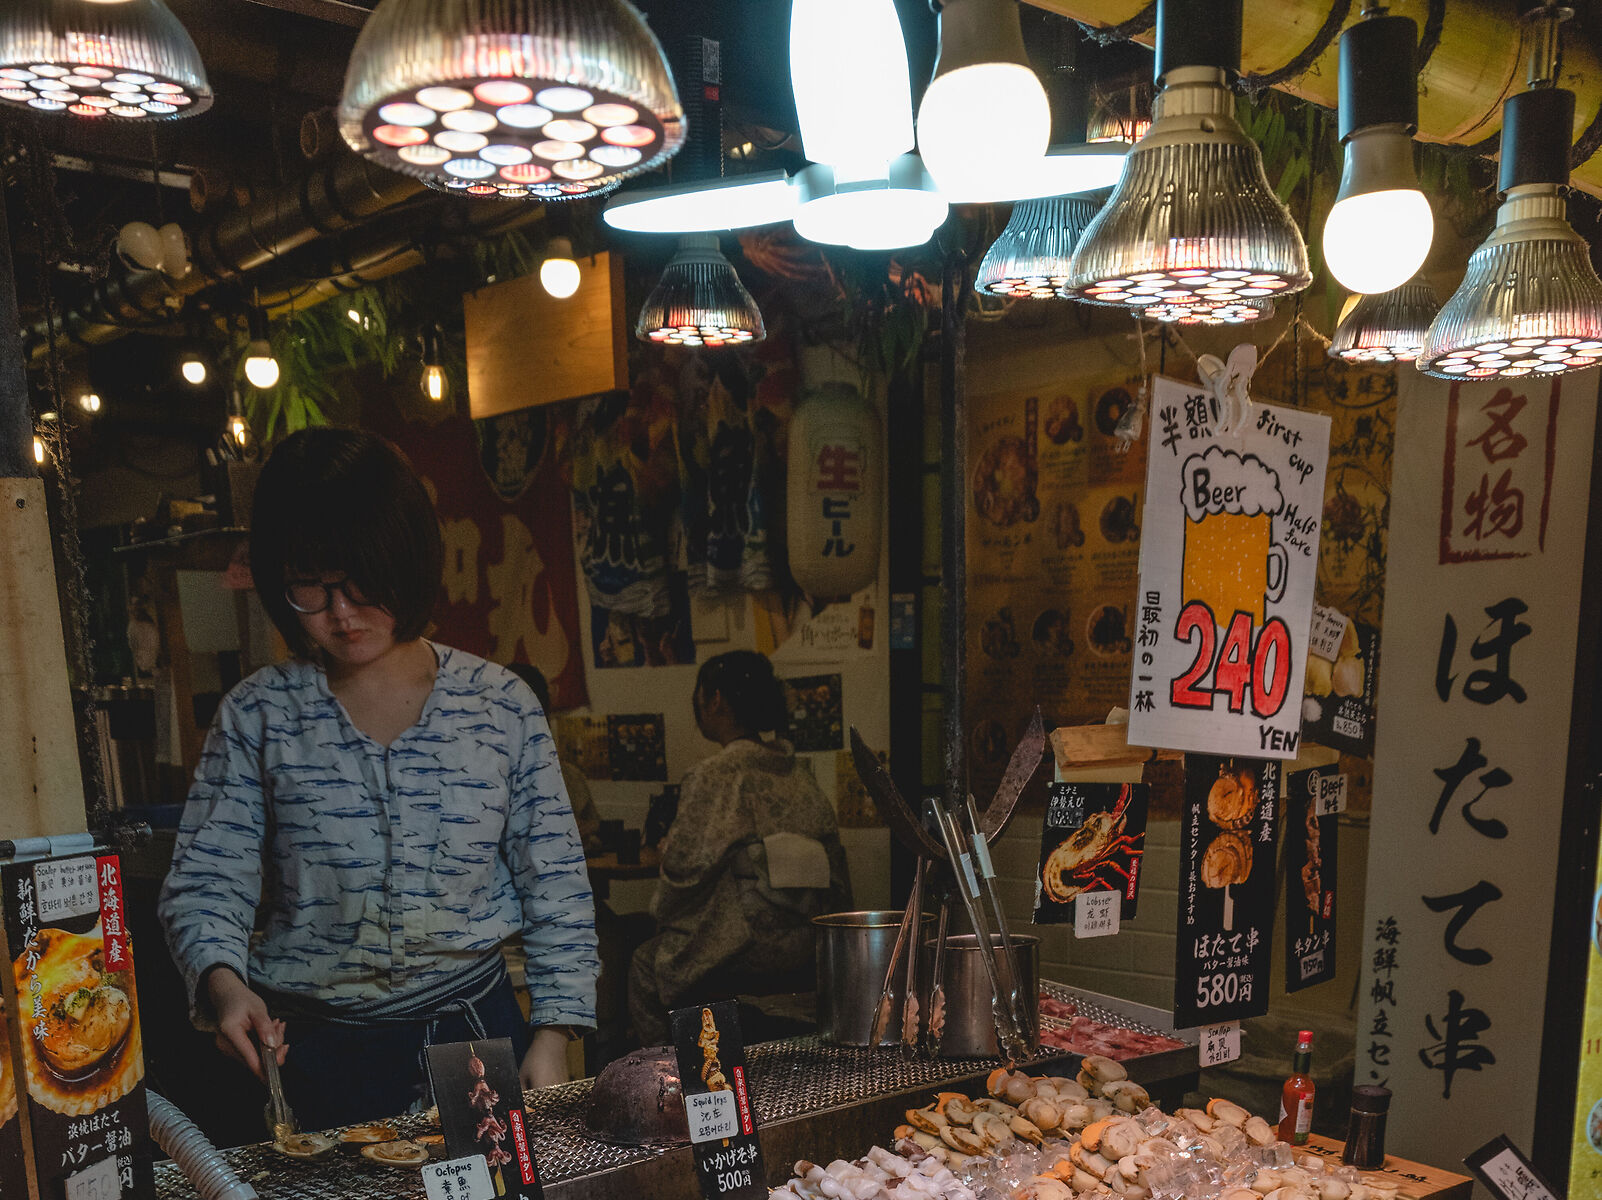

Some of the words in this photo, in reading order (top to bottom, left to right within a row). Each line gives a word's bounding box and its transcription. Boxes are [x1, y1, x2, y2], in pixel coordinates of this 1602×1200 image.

[1256, 410, 1303, 447] first
[1289, 453, 1314, 484] cup
[1465, 387, 1528, 541] 名物
[816, 444, 861, 559] 生ビール
[1193, 469, 1247, 509] Beer
[1284, 503, 1317, 534] Half
[1286, 528, 1312, 557] fare
[1136, 592, 1161, 712] 最初の一杯
[1170, 600, 1291, 718] 240
[1259, 725, 1299, 753] YEN
[1050, 796, 1085, 809] 伊勢えび
[1258, 762, 1276, 843] 北海道産
[1320, 777, 1344, 799] Beef
[1418, 597, 1532, 1100] ほたて串
[100, 863, 124, 964] 北海道産
[16, 877, 49, 1041] 新鮮だから美味
[1194, 927, 1259, 960] ほたて串
[67, 1110, 121, 1140] 浜焼ほたて
[61, 1133, 133, 1168] バター醤油
[702, 1146, 757, 1173] いかげそ串
[435, 1161, 472, 1179] Octopus
